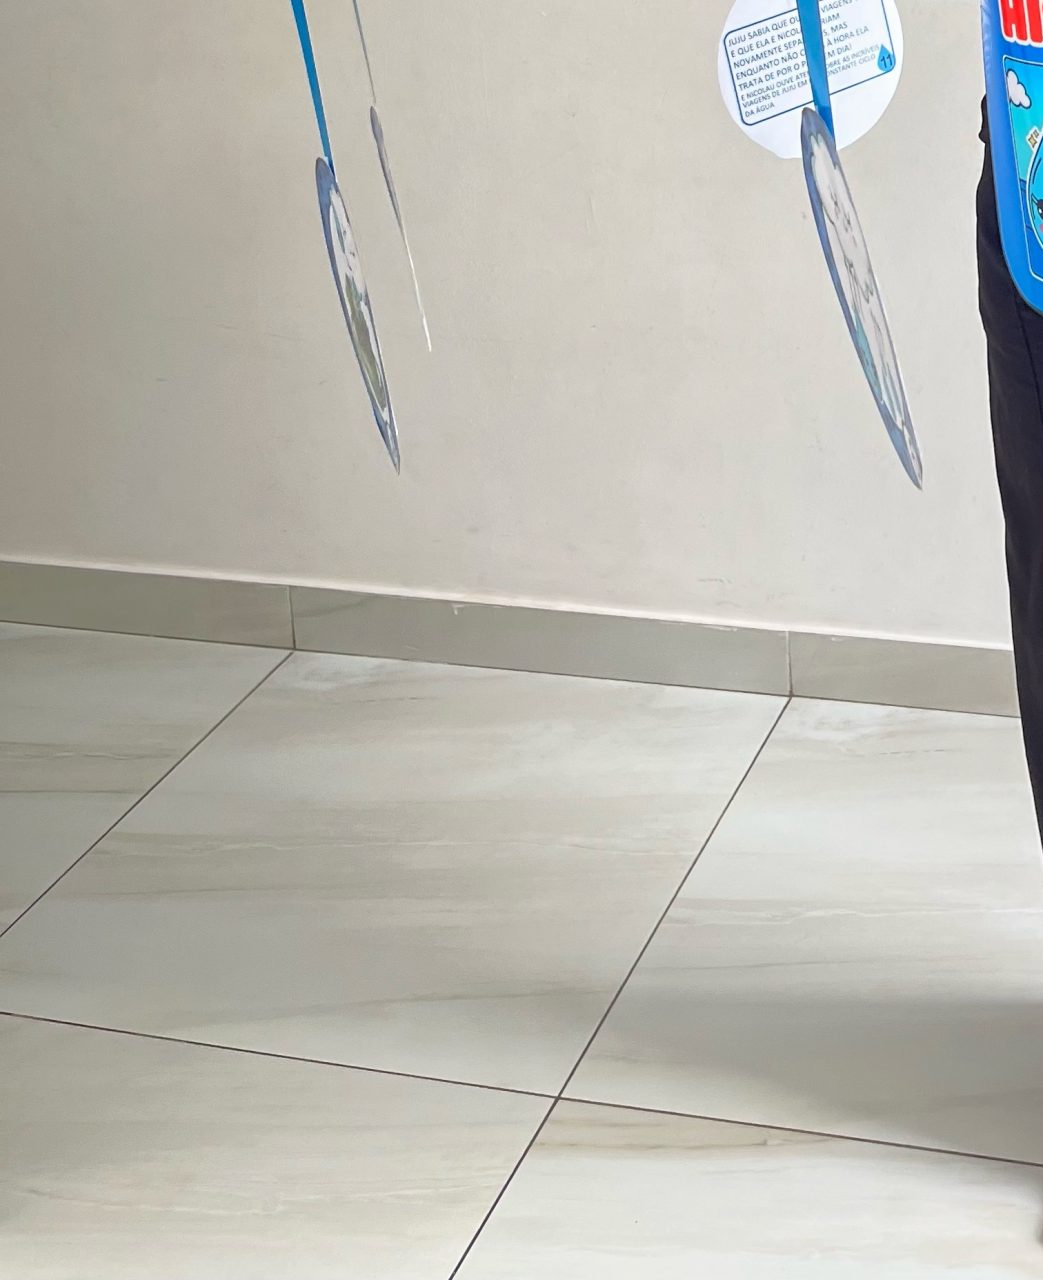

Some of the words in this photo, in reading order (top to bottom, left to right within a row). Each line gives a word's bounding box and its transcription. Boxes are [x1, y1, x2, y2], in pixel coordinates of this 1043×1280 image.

[728, 34, 746, 47] JUJU
[747, 26, 770, 40] SABIA
[772, 20, 788, 31] QUE
[733, 46, 782, 69] NOVAMENTE
[830, 21, 848, 33] MAS
[735, 58, 780, 80] ENQUANTO
[781, 50, 798, 63] NÃO
[834, 31, 854, 44] HORA
[855, 25, 869, 36] ELA
[737, 44, 754, 56] QUE
[756, 38, 770, 49] ELA
[880, 54, 893, 69] 11
[738, 76, 764, 91] TRATA
[764, 72, 775, 81] DE
[776, 65, 792, 77] POR
[793, 63, 800, 71] O
[746, 84, 775, 99] NICOLAU
[776, 76, 794, 87] OUVE
[742, 93, 771, 108] VIAGENS
[771, 90, 780, 98] DE
[745, 109, 755, 118] DA
